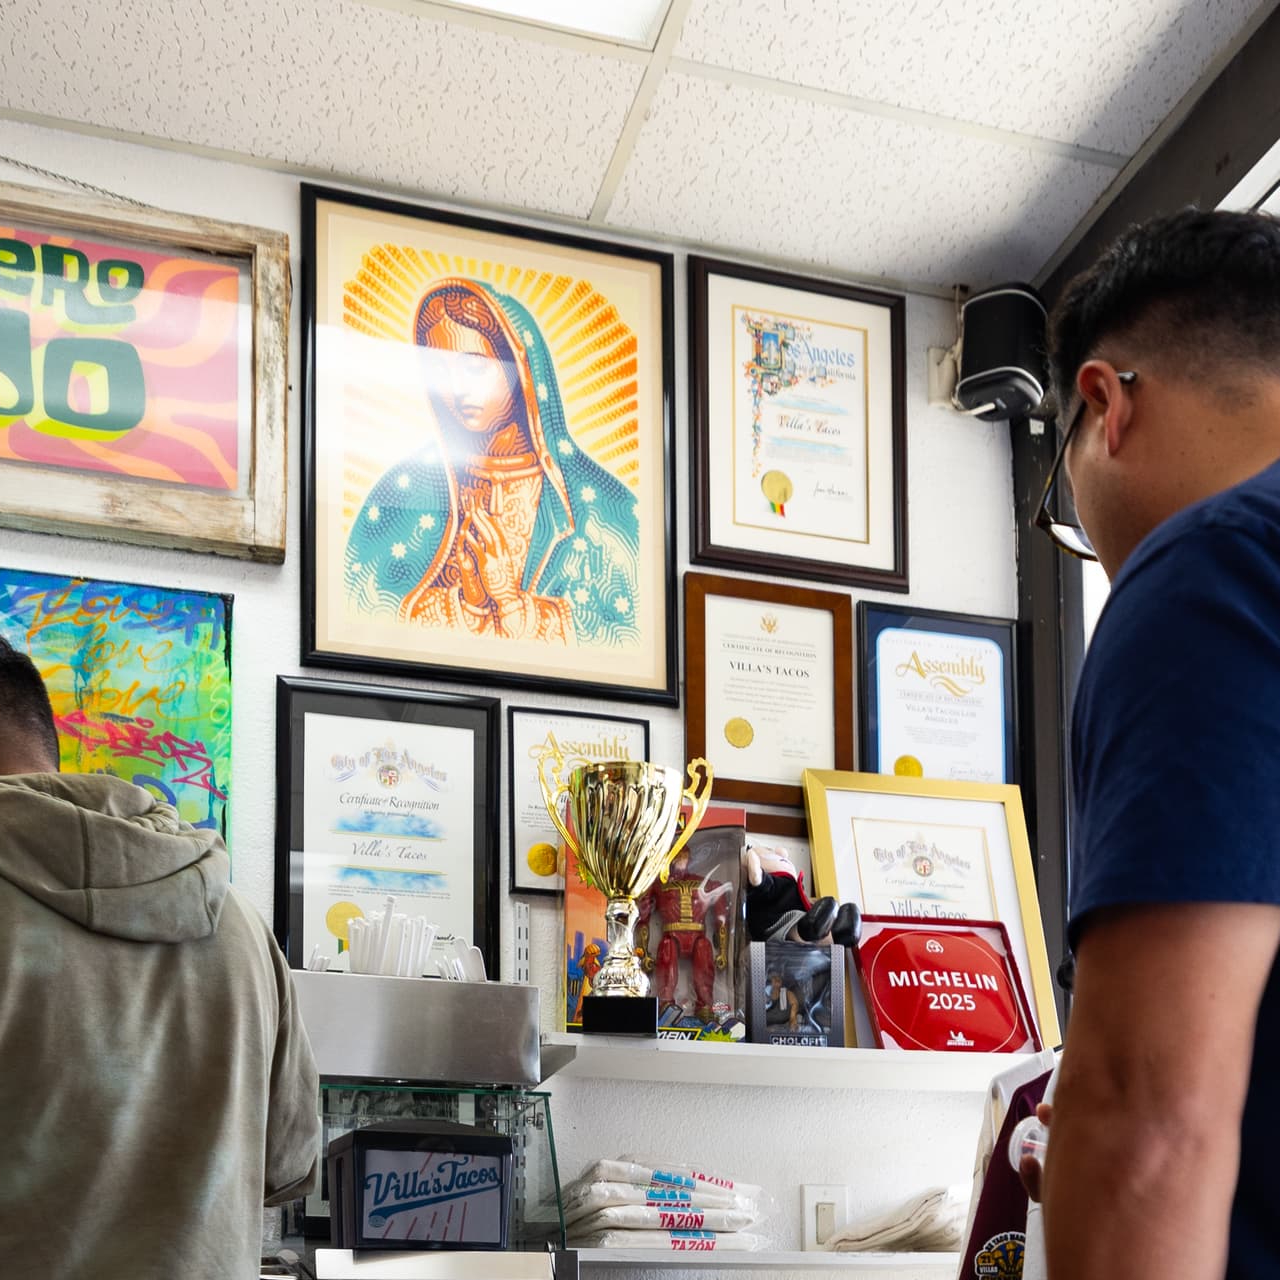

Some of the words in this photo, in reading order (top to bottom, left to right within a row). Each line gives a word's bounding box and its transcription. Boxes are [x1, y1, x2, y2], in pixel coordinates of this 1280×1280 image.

[729, 660, 772, 673] VILLA'S
[774, 665, 810, 679] TACOS
[895, 650, 985, 684] Assembly
[528, 730, 631, 761] Assembly
[389, 795, 440, 811] Recognition
[352, 839, 391, 858] Villa's
[396, 846, 427, 861] Tacos
[890, 900, 929, 919] Villa's
[931, 904, 968, 920] Tacos
[888, 970, 999, 991] MICHELIN
[927, 992, 977, 1011] 2025
[364, 1171, 442, 1206] Villa's
[436, 1156, 503, 1194] Tacos
[659, 1212, 705, 1229] TAZÓN
